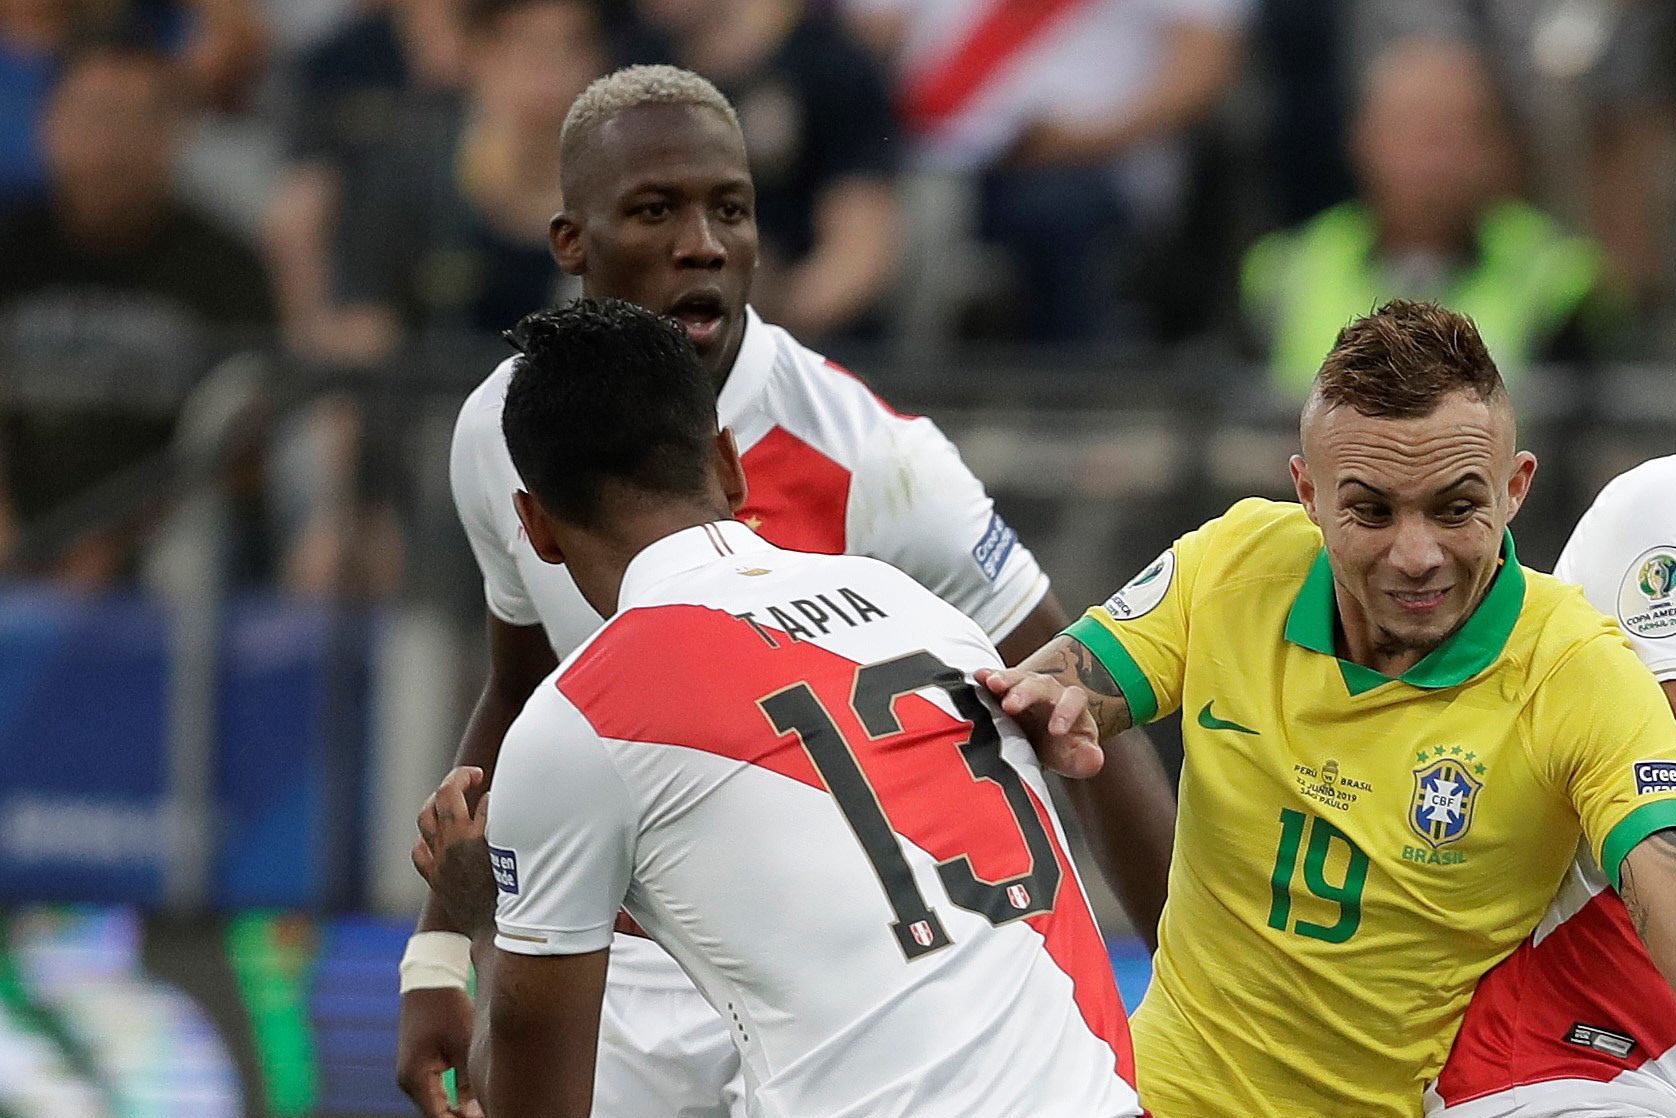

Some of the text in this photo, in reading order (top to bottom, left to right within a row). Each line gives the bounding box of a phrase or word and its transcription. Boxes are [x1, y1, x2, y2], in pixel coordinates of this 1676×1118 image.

[734, 587, 888, 649] TAPIA
[1340, 777, 1373, 792] BRASIL
[1319, 796, 1349, 811] PAULO
[1336, 790, 1357, 802] 2019
[1431, 794, 1455, 807] CBF
[753, 649, 1062, 962] 13
[1401, 844, 1467, 865] BRASIL
[1266, 806, 1370, 945] 19
